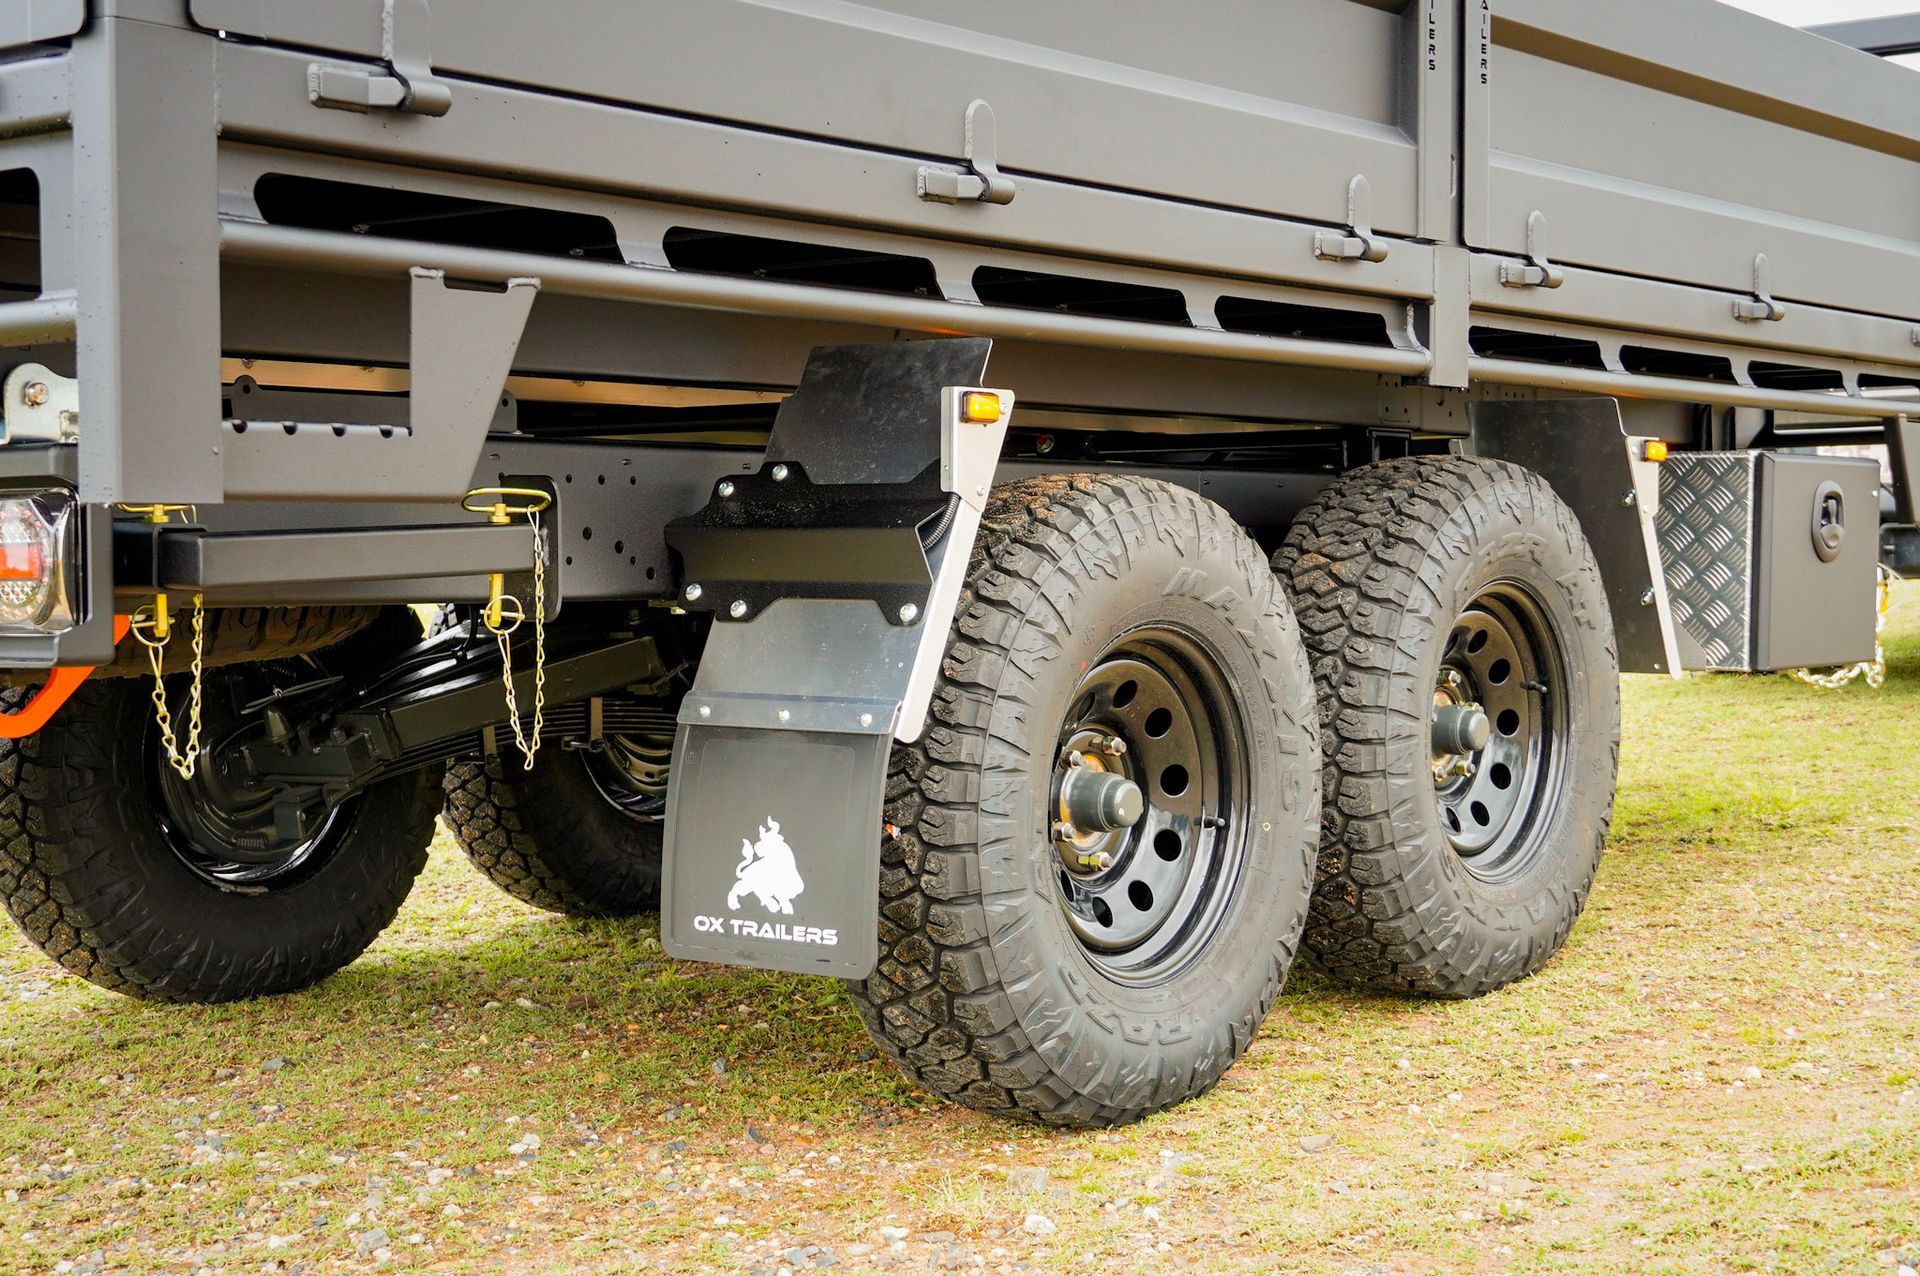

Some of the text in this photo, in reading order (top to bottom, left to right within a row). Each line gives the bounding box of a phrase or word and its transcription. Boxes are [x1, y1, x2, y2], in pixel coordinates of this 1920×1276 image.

[1162, 566, 1301, 815] MAXXIS
[693, 915, 838, 945] OX TRAILERS
